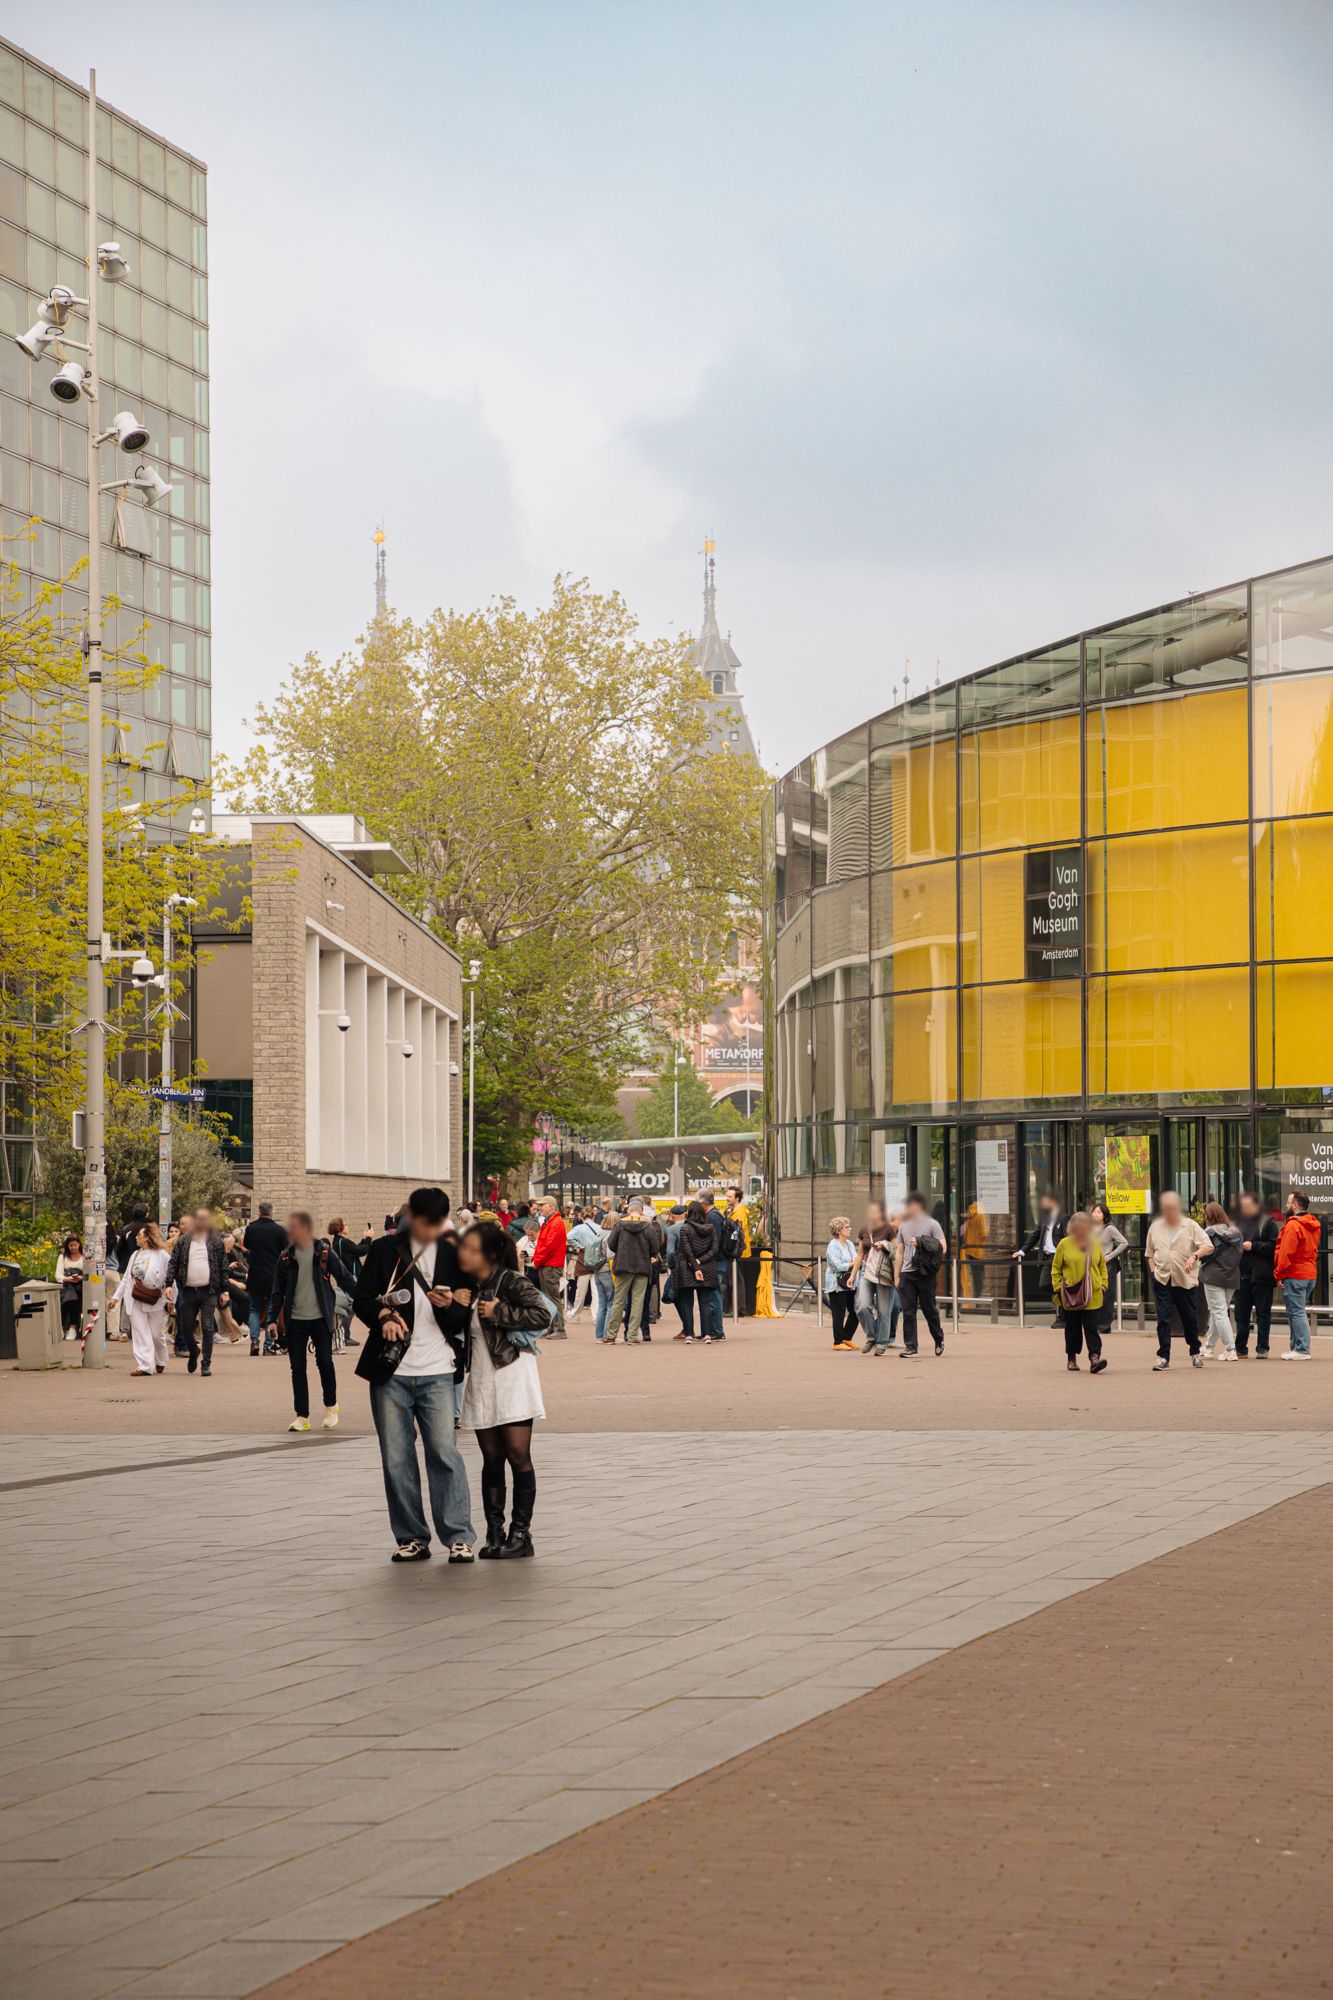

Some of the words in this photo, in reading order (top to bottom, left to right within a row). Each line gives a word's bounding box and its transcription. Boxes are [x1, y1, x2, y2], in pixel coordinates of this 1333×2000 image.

[1056, 866, 1078, 885] Van
[1048, 888, 1078, 911] Gogh
[1033, 916, 1079, 935] Museum
[1042, 947, 1079, 960] Amsterdam
[1311, 1143, 1333, 1155] Van
[1304, 1158, 1333, 1172] Gogh
[688, 1179, 739, 1189] MUSEUM
[1289, 1173, 1333, 1186] Museum
[1107, 1192, 1130, 1203] Yellow
[1308, 1195, 1333, 1203] sterdam
